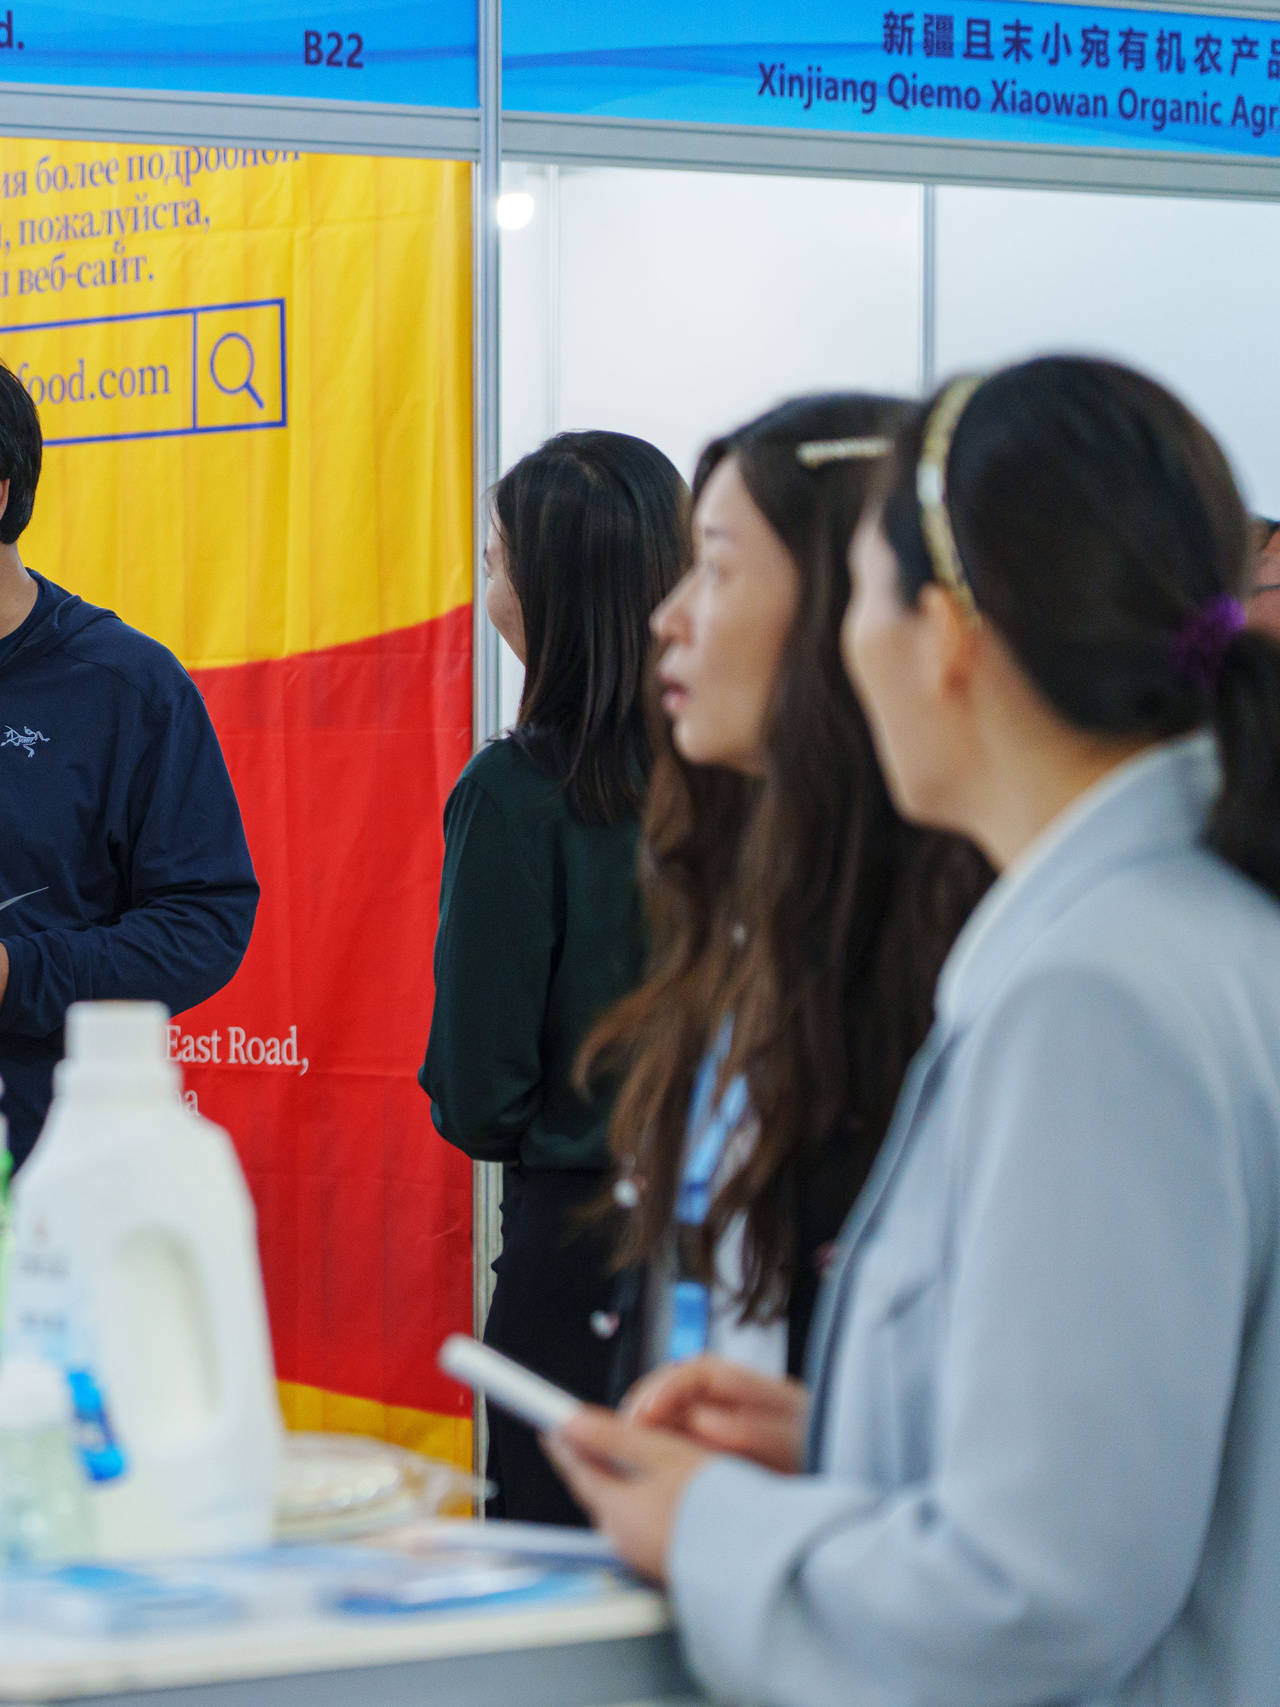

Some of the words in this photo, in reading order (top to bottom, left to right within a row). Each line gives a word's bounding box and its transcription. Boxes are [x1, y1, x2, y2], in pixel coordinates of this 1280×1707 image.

[304, 29, 364, 69] B22
[757, 62, 878, 115] Xinjiang
[887, 72, 982, 112] Qiemo
[990, 79, 1108, 119] Xiaowan
[1118, 87, 1223, 132] Organic
[1230, 94, 1280, 138] Agr
[36, 154, 120, 195] более
[19, 191, 211, 250] пожалуйста,
[17, 240, 155, 296] веб-сайт.
[166, 1024, 222, 1064] East
[227, 1024, 310, 1077] Road,
